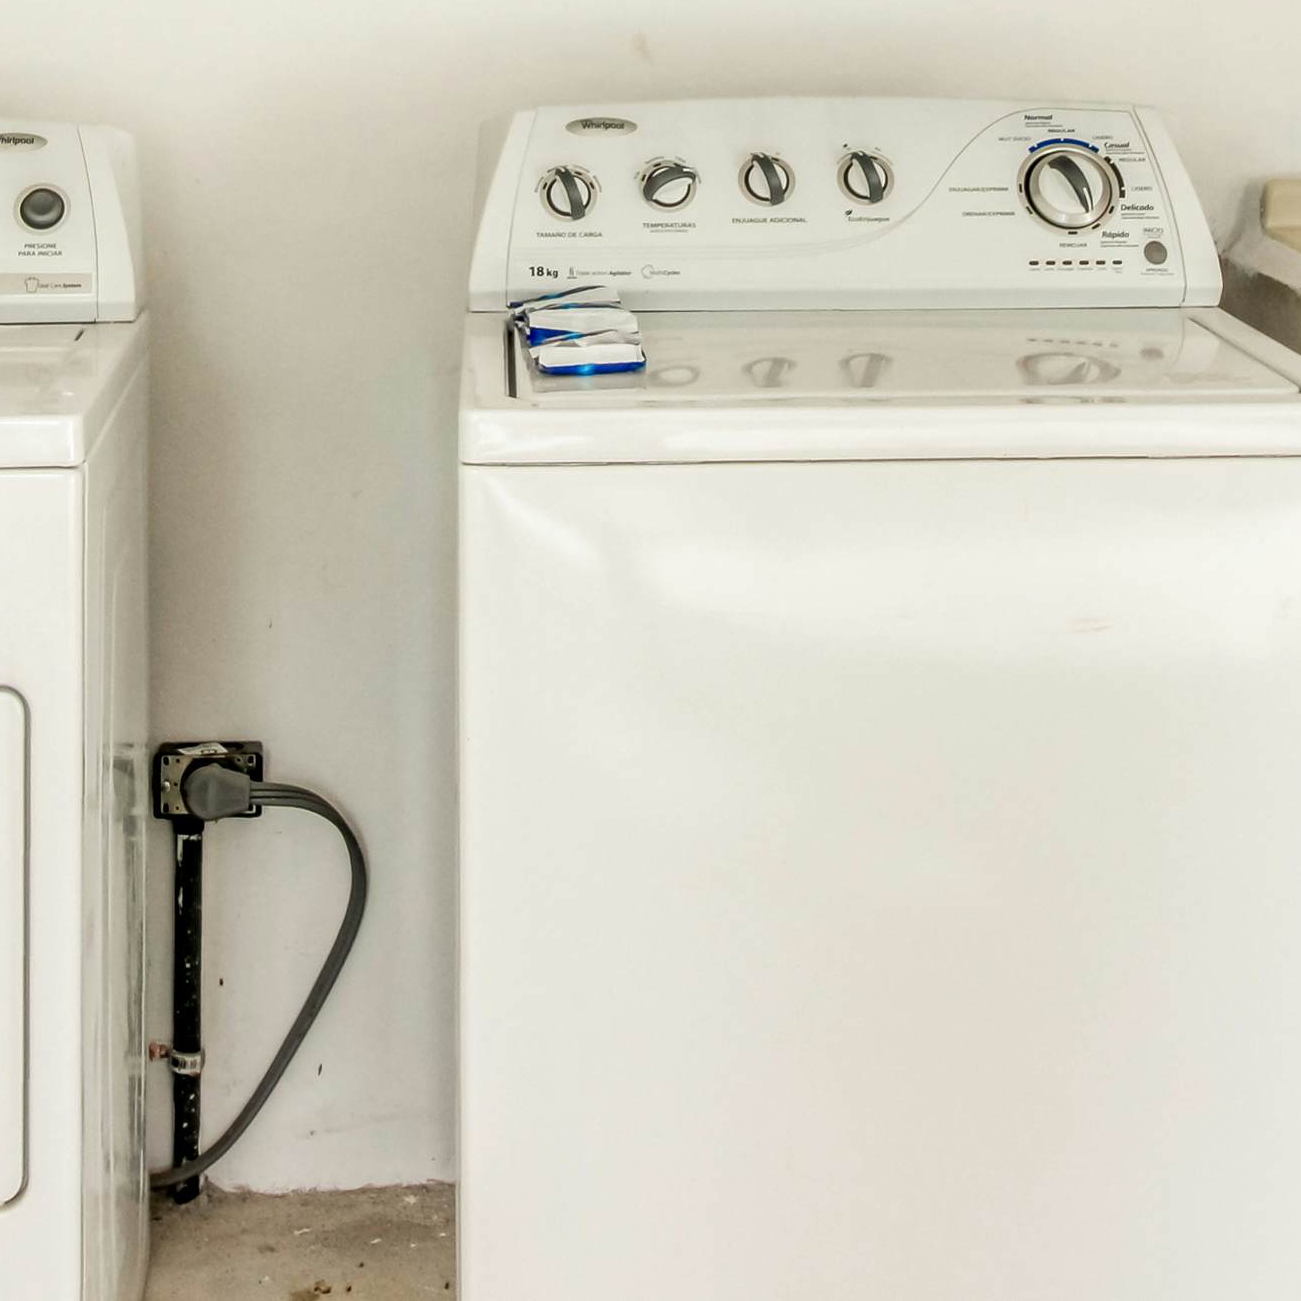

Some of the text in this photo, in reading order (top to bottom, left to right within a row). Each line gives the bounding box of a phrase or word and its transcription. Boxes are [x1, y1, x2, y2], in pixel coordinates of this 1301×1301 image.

[581, 121, 626, 131] Whirlpool
[529, 266, 559, 278] 18 kg
